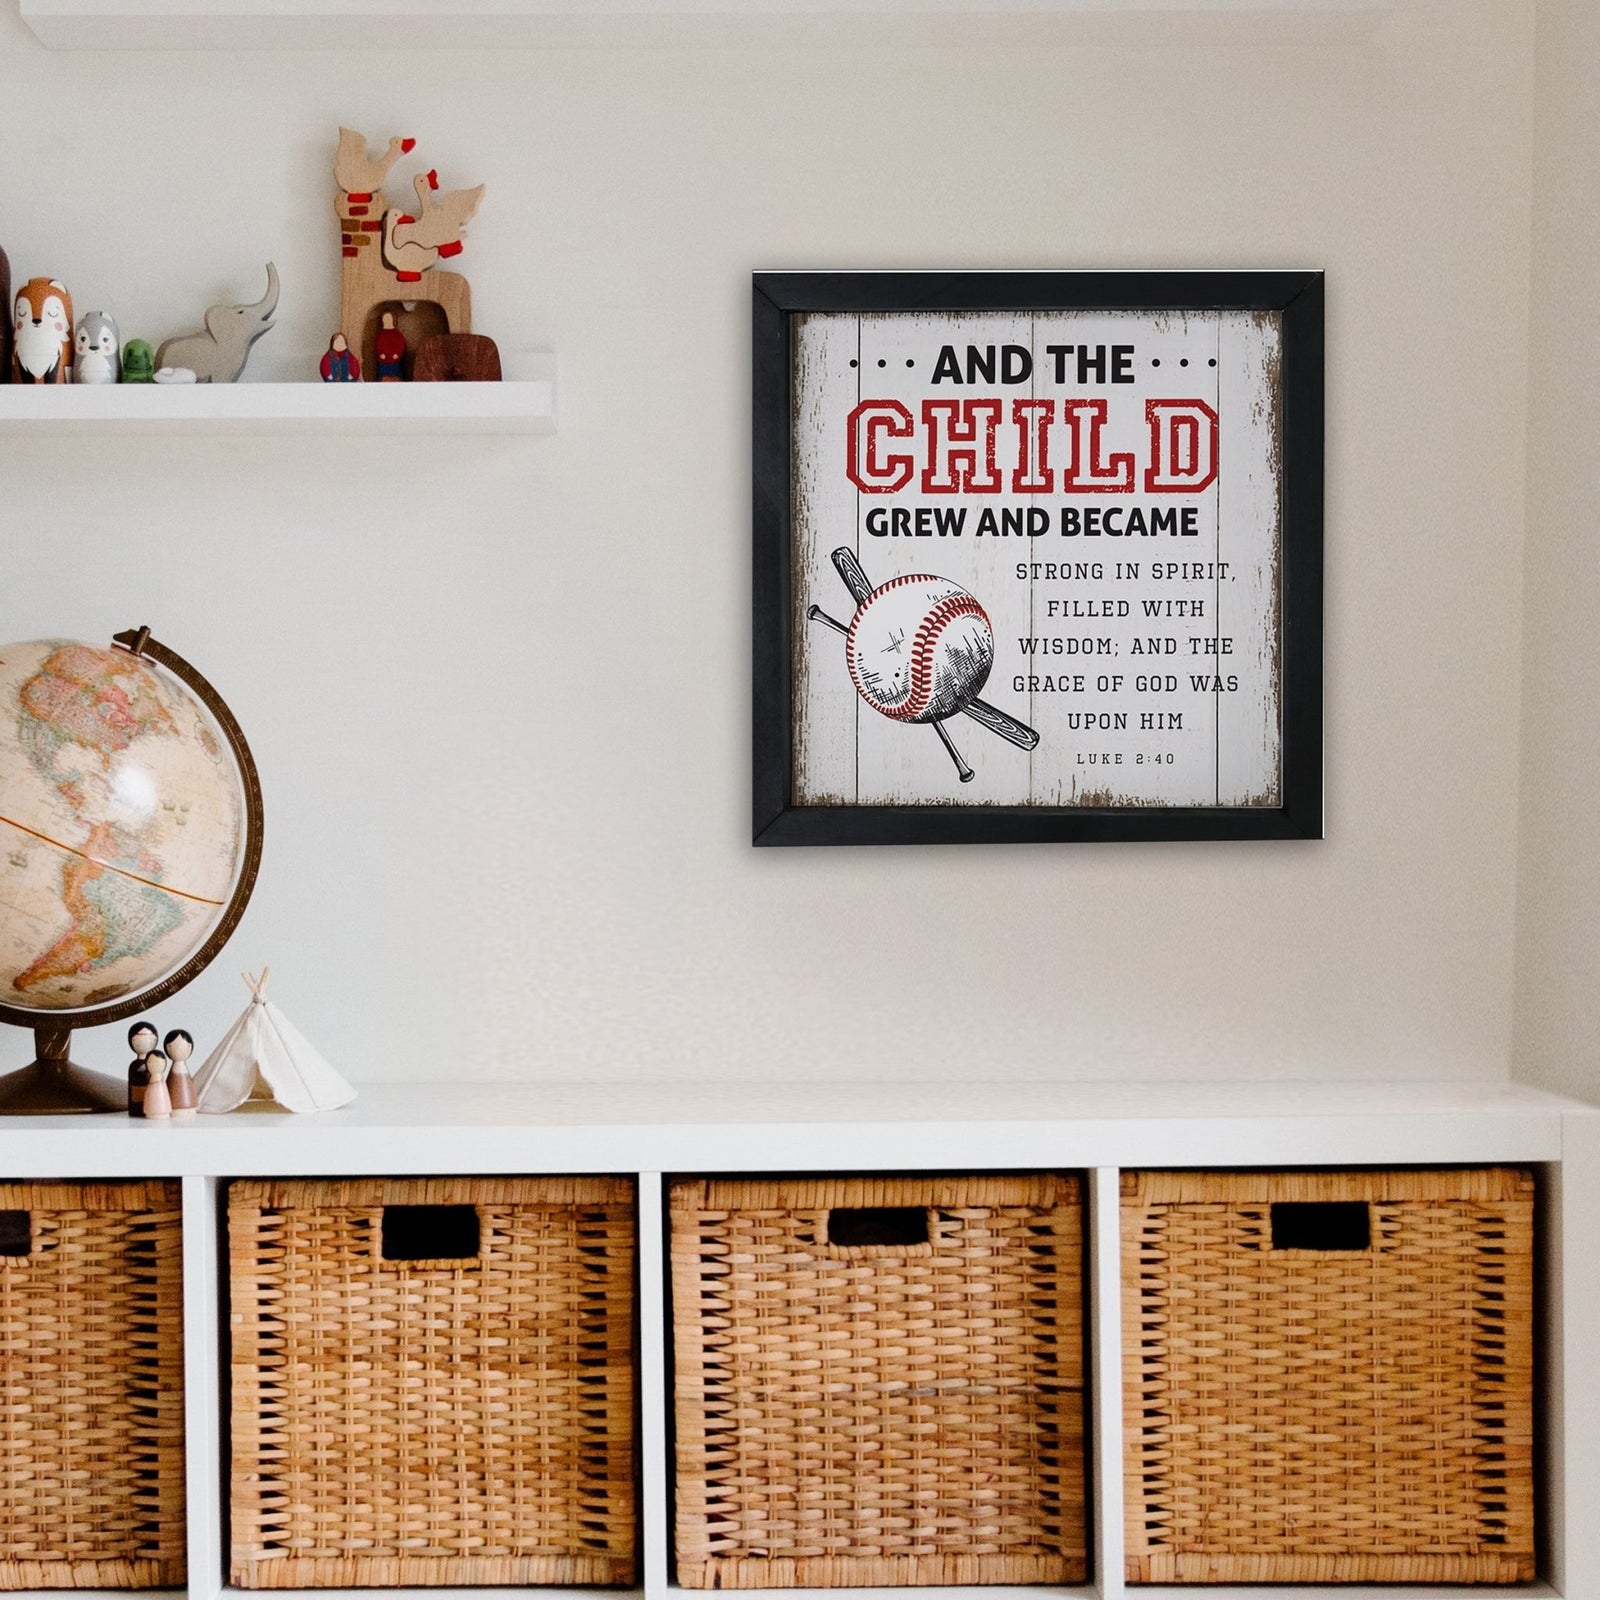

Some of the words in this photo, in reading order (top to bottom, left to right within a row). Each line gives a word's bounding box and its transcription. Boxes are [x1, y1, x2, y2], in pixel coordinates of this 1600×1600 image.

[930, 344, 1034, 385] AND
[1045, 344, 1136, 385] THE
[846, 398, 1218, 494] CHILD
[865, 507, 968, 537] GREW
[975, 507, 1051, 537] AND
[1060, 507, 1199, 537] BECAME
[1016, 562, 1104, 581] STRONG
[1115, 562, 1140, 580] IN
[1151, 562, 1236, 582] SPIRIT,
[1047, 600, 1130, 618] FILLED
[1141, 600, 1205, 617] WITH
[1017, 637, 1119, 657] WISDOM;
[1130, 637, 1177, 655] AND
[1188, 637, 1233, 655] THE
[1013, 675, 1085, 693] GRACE
[1097, 675, 1124, 693] OF
[1135, 675, 1178, 693] GOD
[1189, 675, 1240, 693] WAS
[1067, 712, 1128, 730] UPON
[1140, 712, 1183, 730] HIM
[1077, 753, 1123, 765] LUKE
[1135, 753, 1174, 765] 2:40
